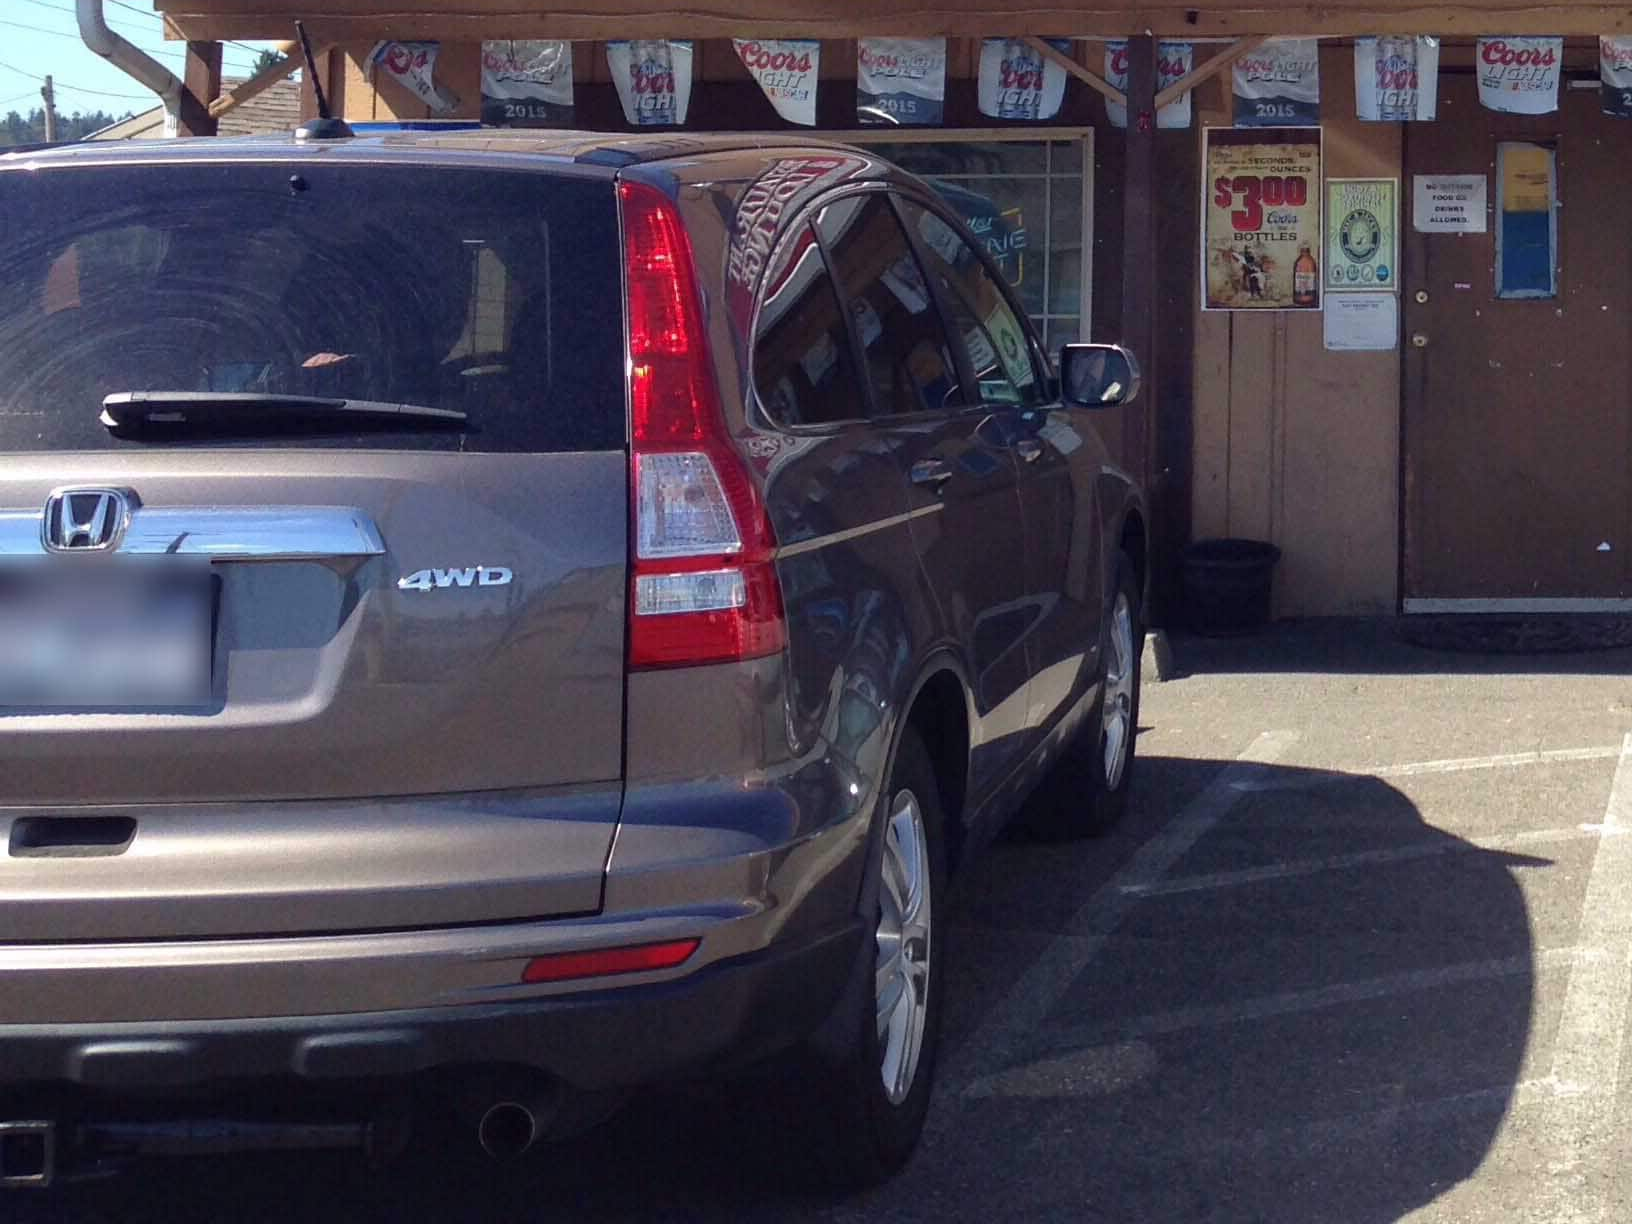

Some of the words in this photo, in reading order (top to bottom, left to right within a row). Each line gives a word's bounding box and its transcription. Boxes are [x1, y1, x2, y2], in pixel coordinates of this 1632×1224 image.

[740, 41, 812, 72] Coors
[1481, 41, 1556, 66] Coors
[505, 104, 547, 118] 2015
[877, 99, 916, 114] 2015
[1255, 104, 1295, 118] 2015
[1233, 232, 1297, 241] BOTTLES
[397, 566, 513, 591] 4WD
